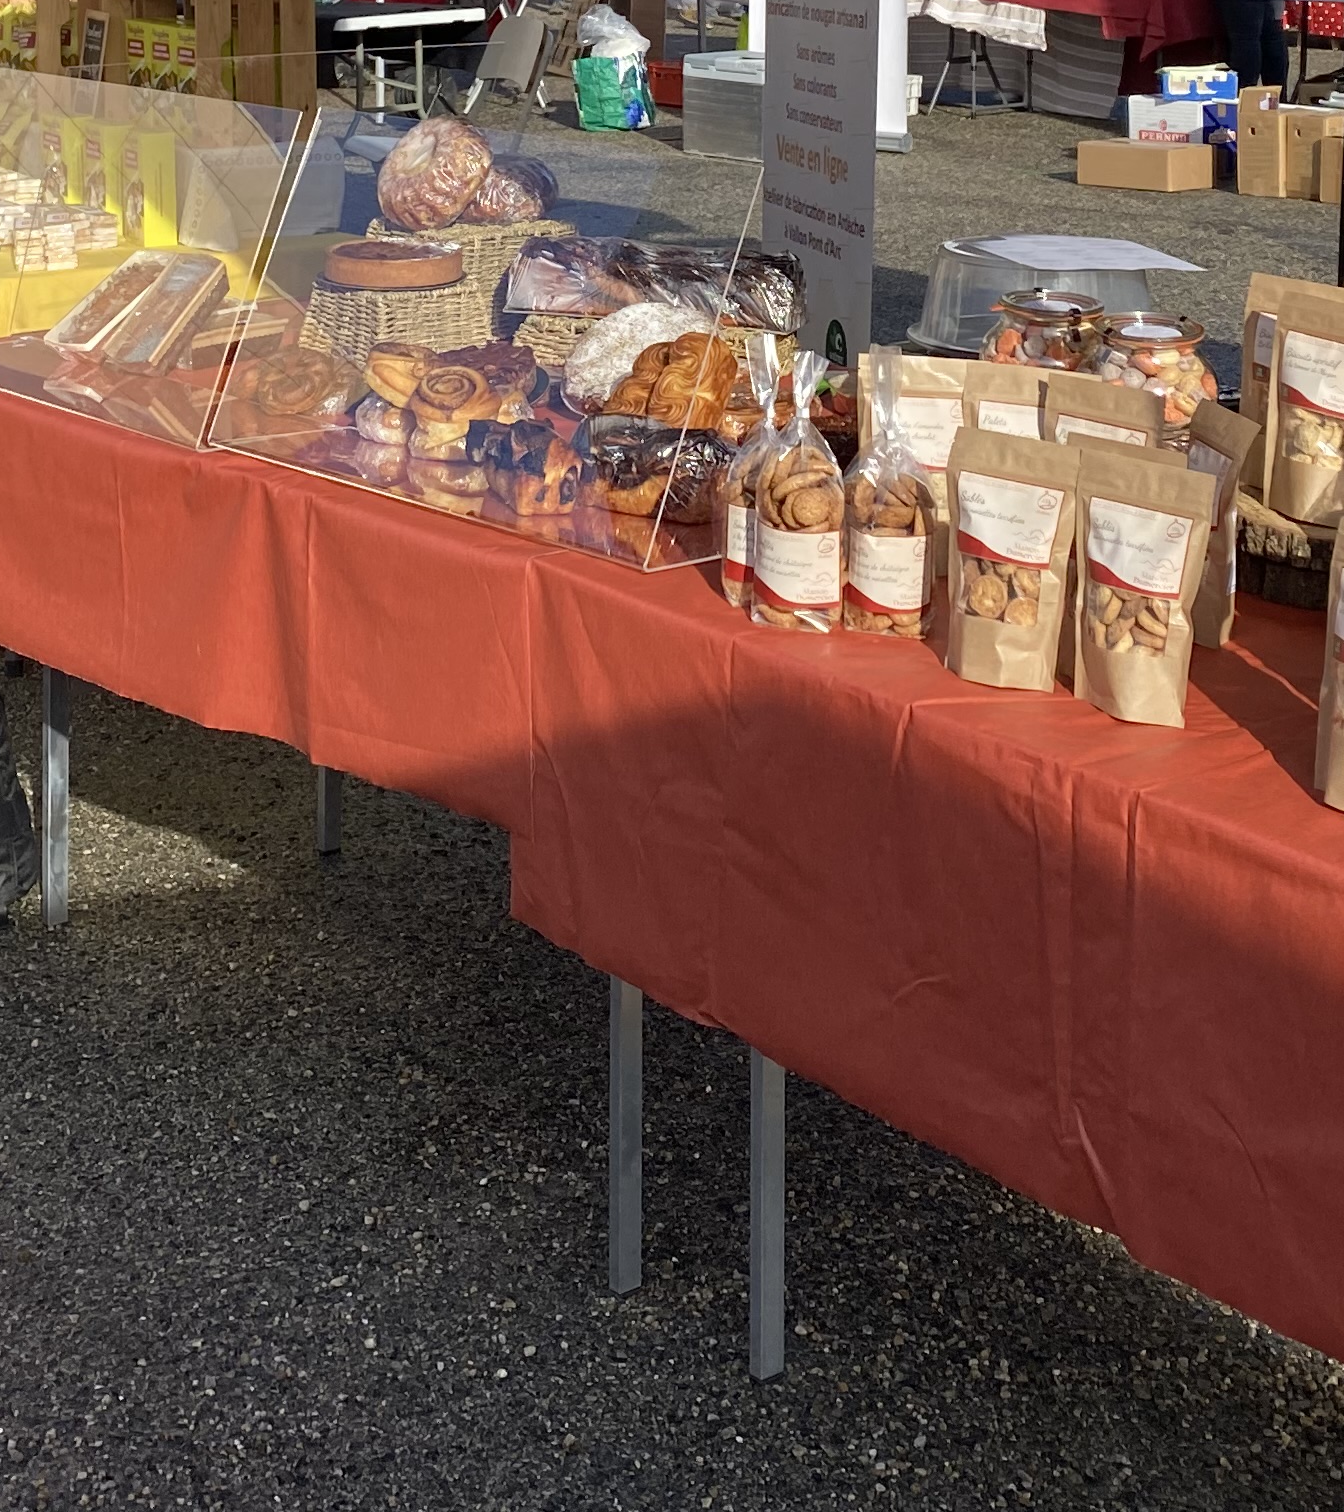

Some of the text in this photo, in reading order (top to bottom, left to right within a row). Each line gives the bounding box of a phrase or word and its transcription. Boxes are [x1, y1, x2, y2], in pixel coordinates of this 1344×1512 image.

[776, 133, 849, 185] Vente en ligne
